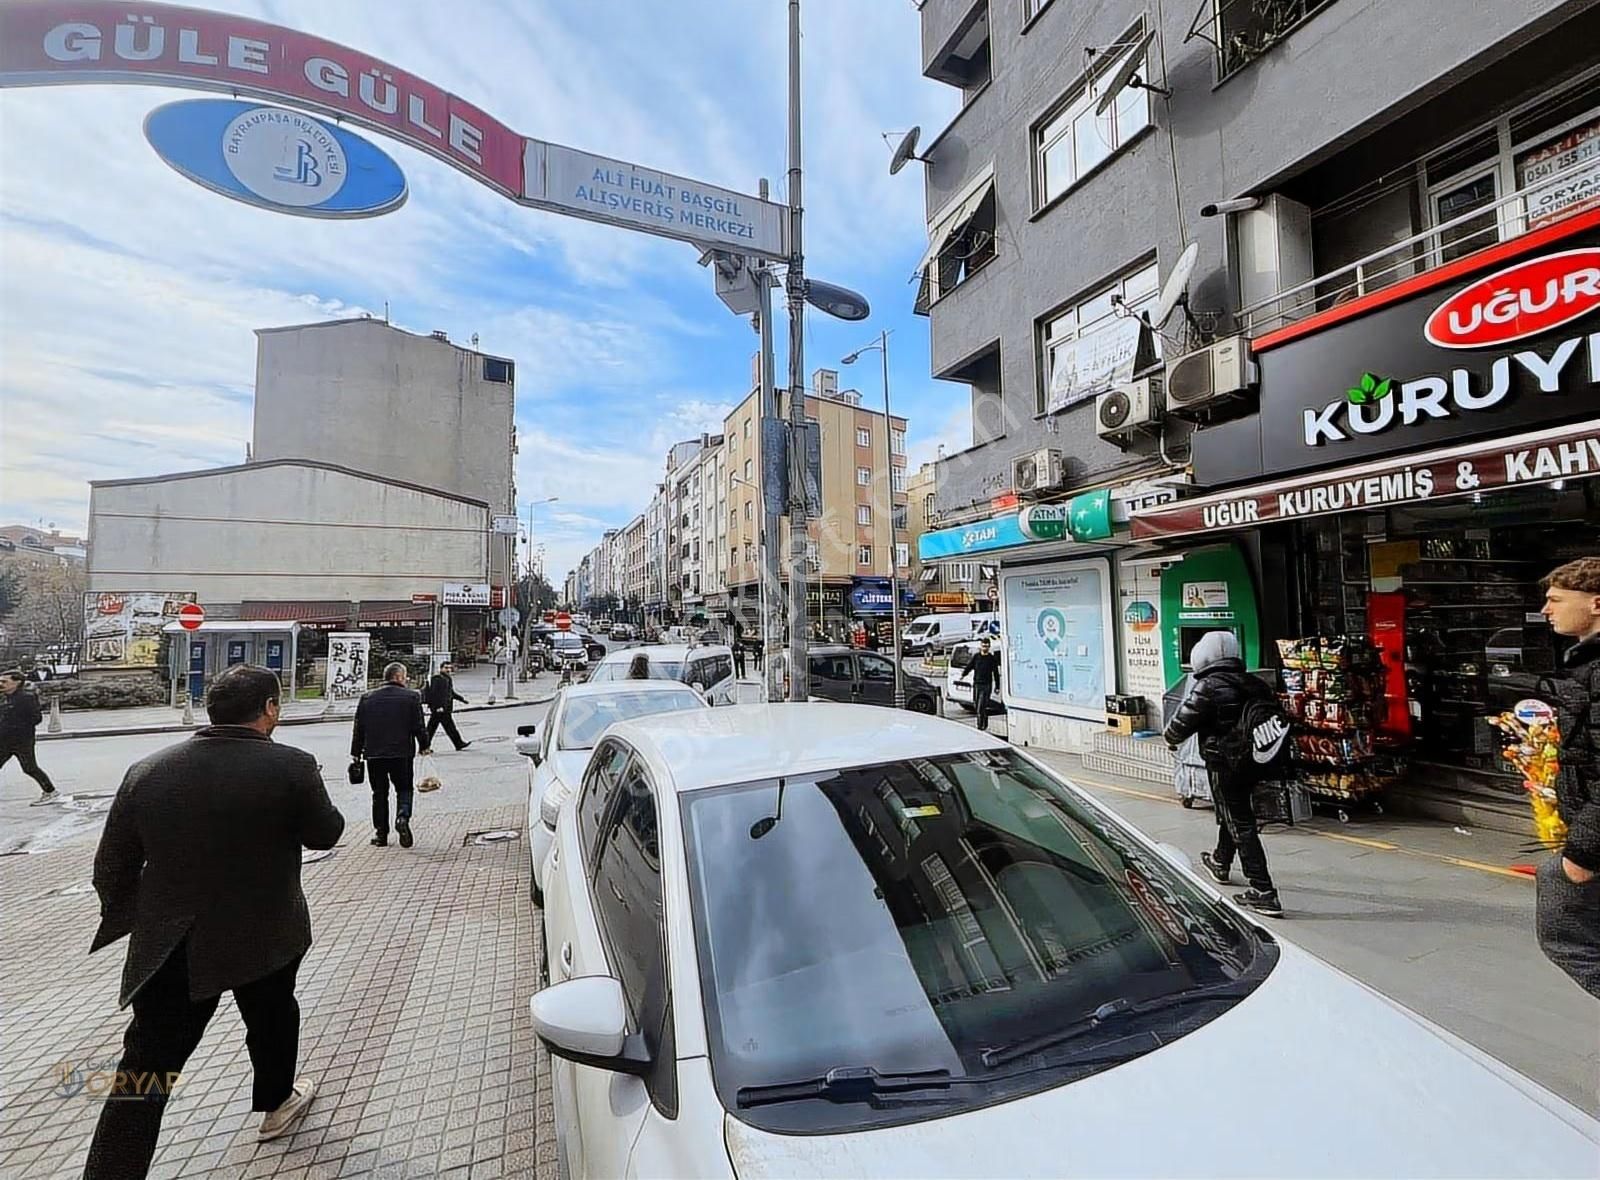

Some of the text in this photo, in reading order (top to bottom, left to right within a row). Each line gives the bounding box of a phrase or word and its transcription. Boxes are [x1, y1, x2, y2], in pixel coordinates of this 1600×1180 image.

[43, 14, 485, 166] GÜLE GÜLE
[592, 167, 742, 217] ALİ FUAT BAŞGİL
[1527, 162, 1553, 182] 0541
[575, 185, 755, 238] ALIŞVERİŞ MERKEZİ
[1448, 267, 1600, 336] UĞUR
[1033, 508, 1056, 520] ATM
[1203, 499, 1258, 528] UĞUR
[1279, 466, 1434, 518] KURUYEMİŞ
[1456, 461, 1480, 490] &
[1253, 715, 1281, 749] NIKE
